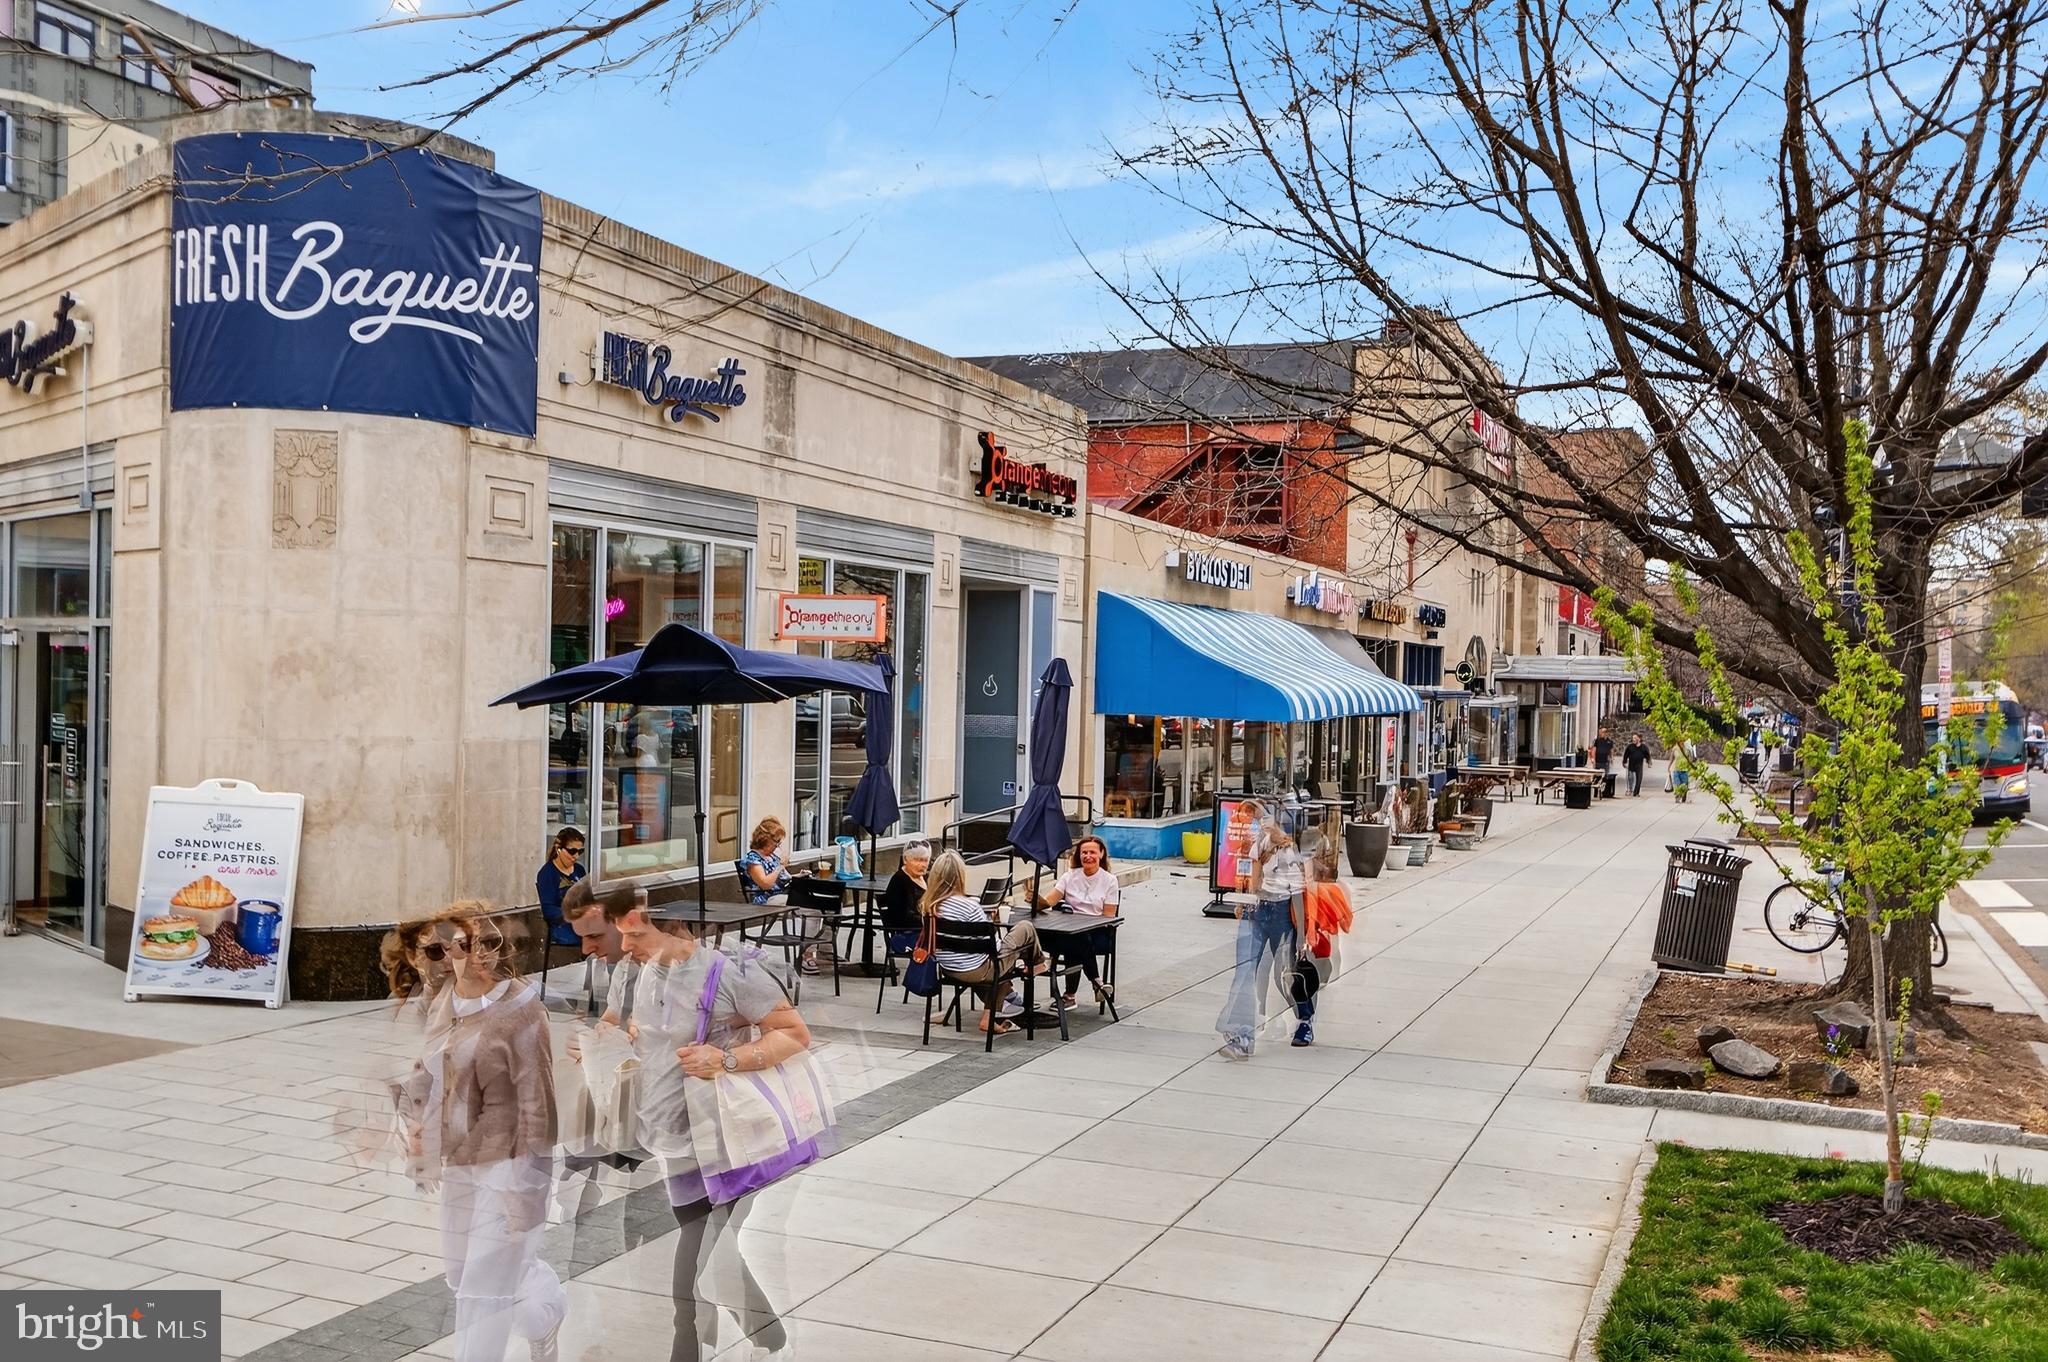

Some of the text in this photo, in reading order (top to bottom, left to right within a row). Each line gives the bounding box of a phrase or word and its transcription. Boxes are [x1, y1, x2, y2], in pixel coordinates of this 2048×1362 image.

[174, 221, 534, 344] FRESH Baguette
[643, 345, 746, 423] Baguette
[1187, 549, 1252, 591] BYBLOS DELI
[174, 838, 265, 852] SANDWICHES.
[213, 853, 279, 865] PASTRIES.
